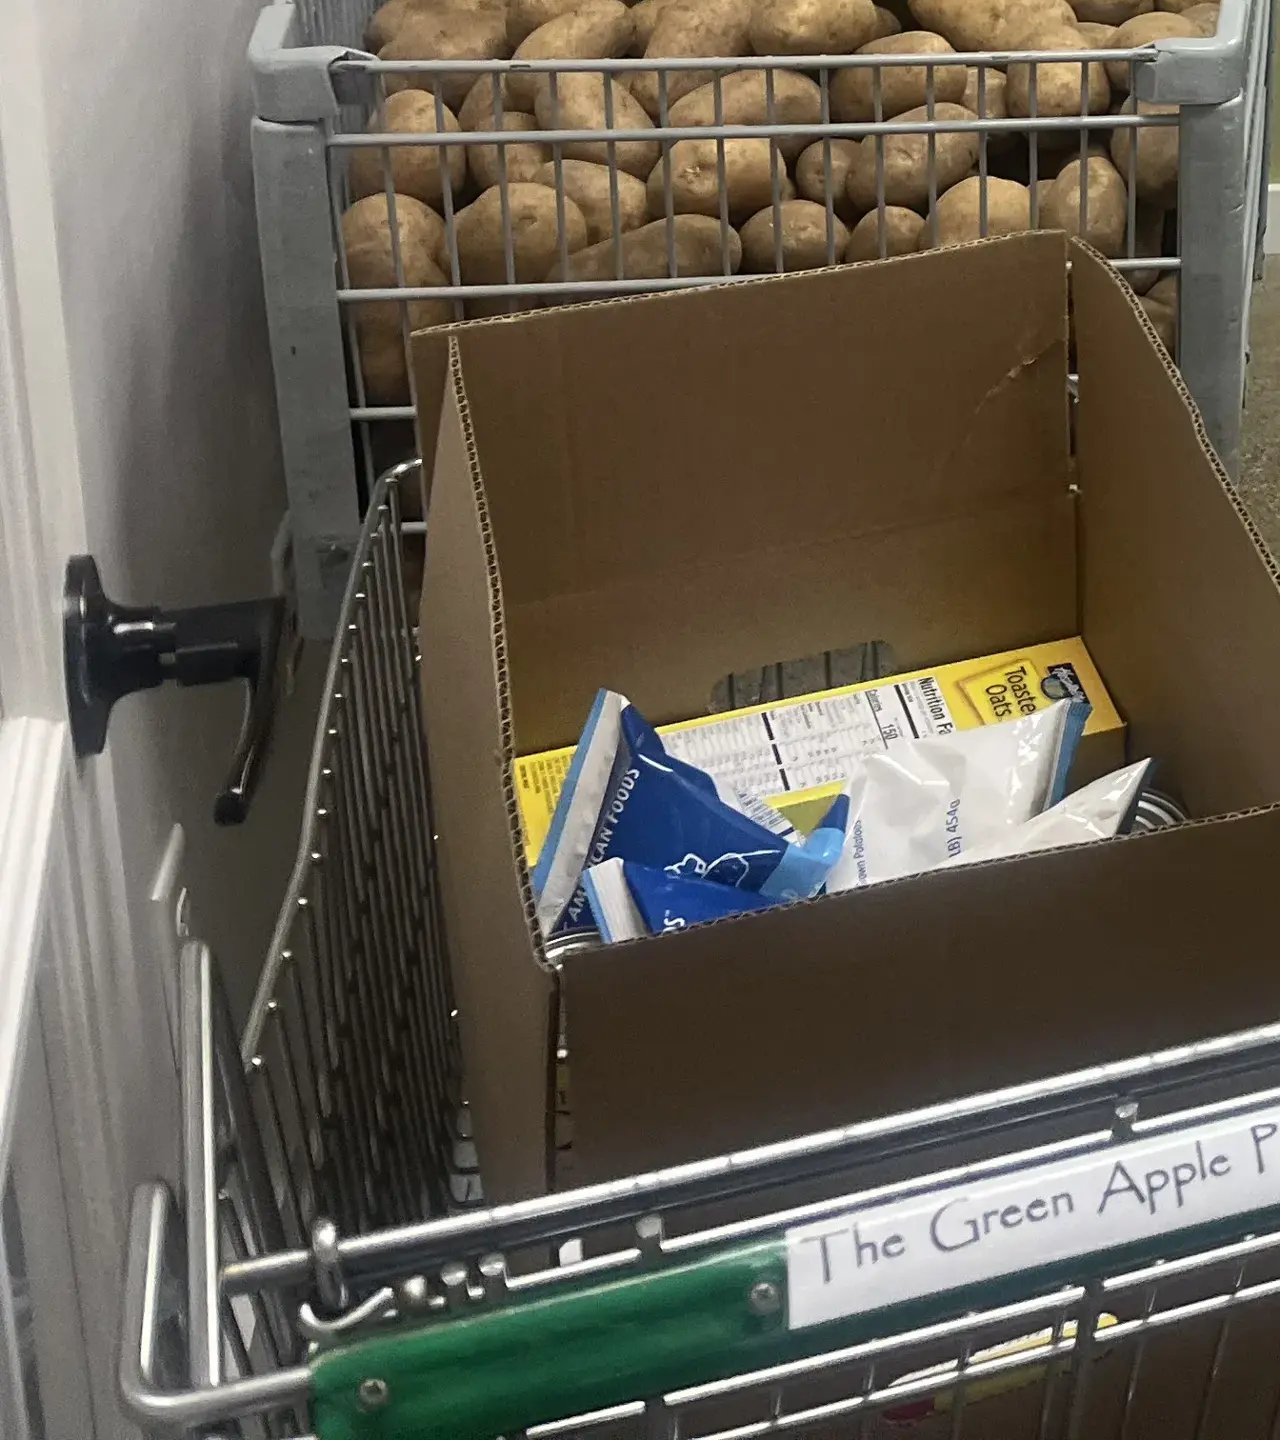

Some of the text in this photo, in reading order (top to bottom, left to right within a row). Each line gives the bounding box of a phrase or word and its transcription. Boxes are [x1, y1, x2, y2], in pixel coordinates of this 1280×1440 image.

[918, 676, 945, 721] Nutrition
[985, 684, 1012, 717] Oats
[1005, 665, 1037, 716] Toaste
[881, 724, 899, 741] 150
[610, 768, 641, 824] FOODS
[799, 1226, 906, 1286] The
[928, 1192, 1075, 1254] Green
[1097, 1140, 1233, 1217] Apple
